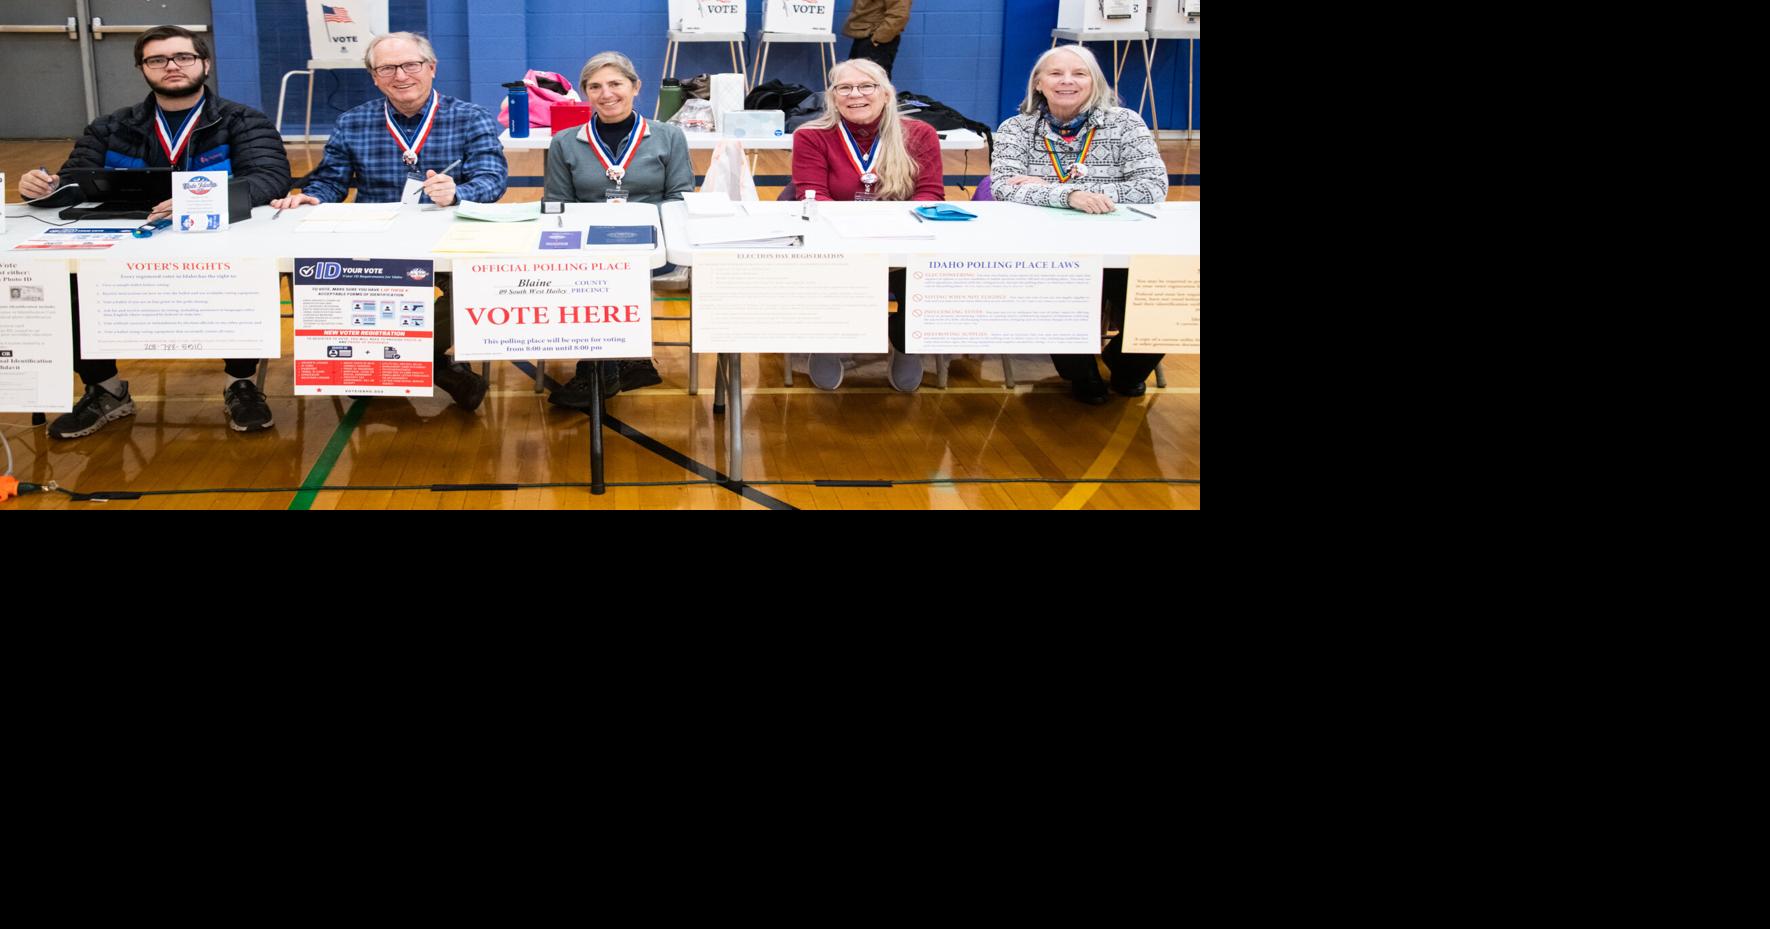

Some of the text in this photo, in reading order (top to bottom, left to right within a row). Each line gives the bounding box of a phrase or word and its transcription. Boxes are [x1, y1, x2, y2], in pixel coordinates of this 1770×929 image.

[707, 5, 738, 14] VOTE
[792, 4, 826, 14] VOTE
[127, 262, 231, 270] VOTER'S RIGHTS
[315, 262, 341, 280] ID
[472, 262, 631, 272] OFFICIAL POLLING PLACE
[518, 279, 552, 287] Blaine
[465, 305, 640, 326] VOTE HERE
